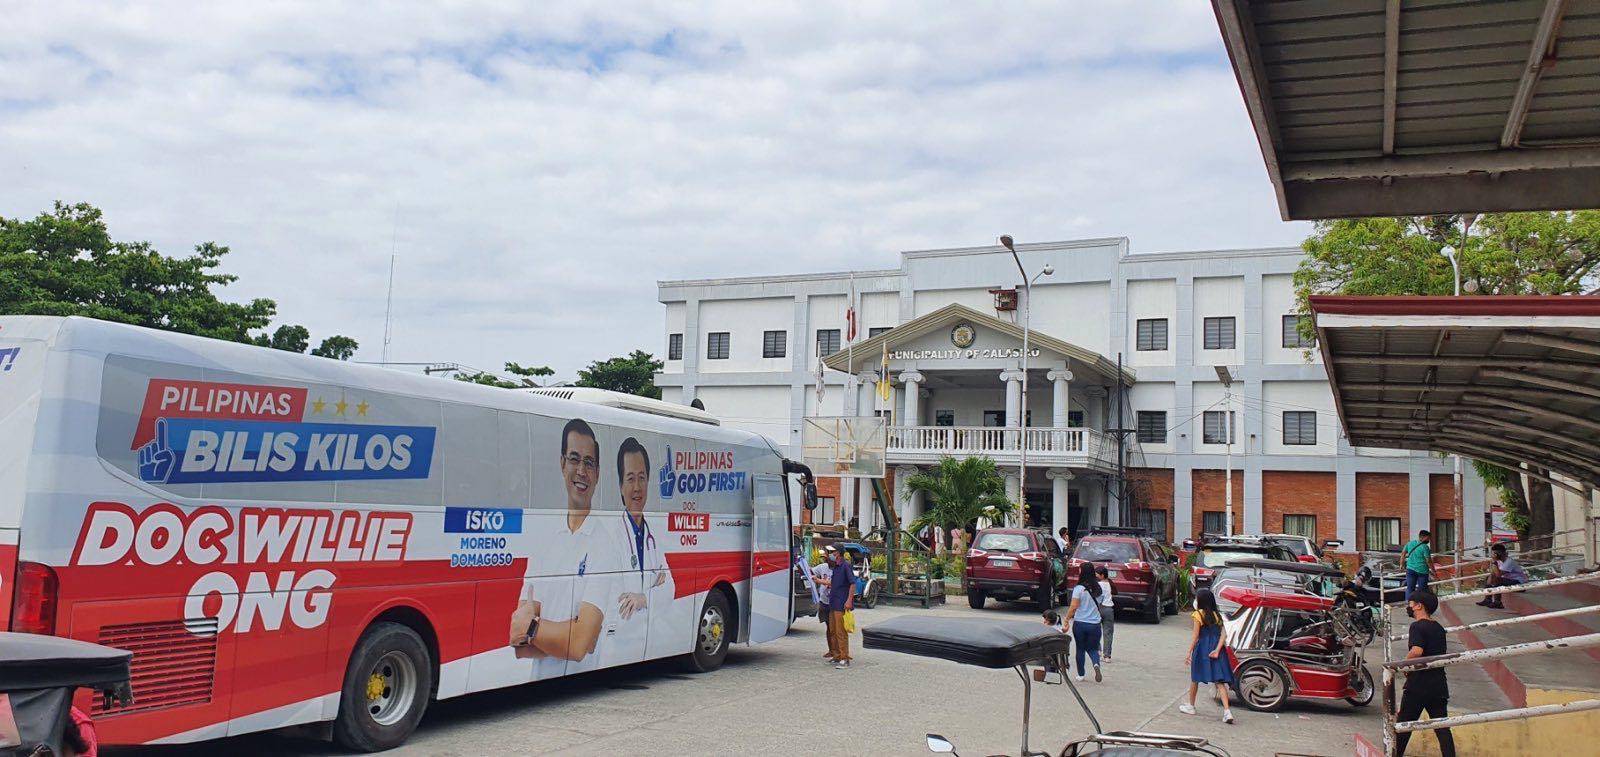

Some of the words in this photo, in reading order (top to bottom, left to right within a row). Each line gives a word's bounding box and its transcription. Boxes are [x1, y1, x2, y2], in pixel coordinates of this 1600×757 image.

[965, 350, 979, 360] OF
[160, 386, 292, 416] PILIPINAS
[180, 430, 300, 473] BILIS
[304, 433, 414, 472] KILOS
[675, 451, 733, 470] PILIPINAS
[677, 473, 707, 494] GOD
[708, 471, 746, 492] FIRST!
[682, 501, 696, 511] DOC
[465, 510, 505, 530] ISKO
[674, 515, 705, 530] WILLIE
[76, 508, 231, 566] DOC
[244, 513, 412, 564] WILLIE
[460, 537, 507, 550] MORENO
[680, 534, 697, 546] ONG
[451, 553, 513, 567] DOMAGOSO
[184, 569, 337, 637] ONG
